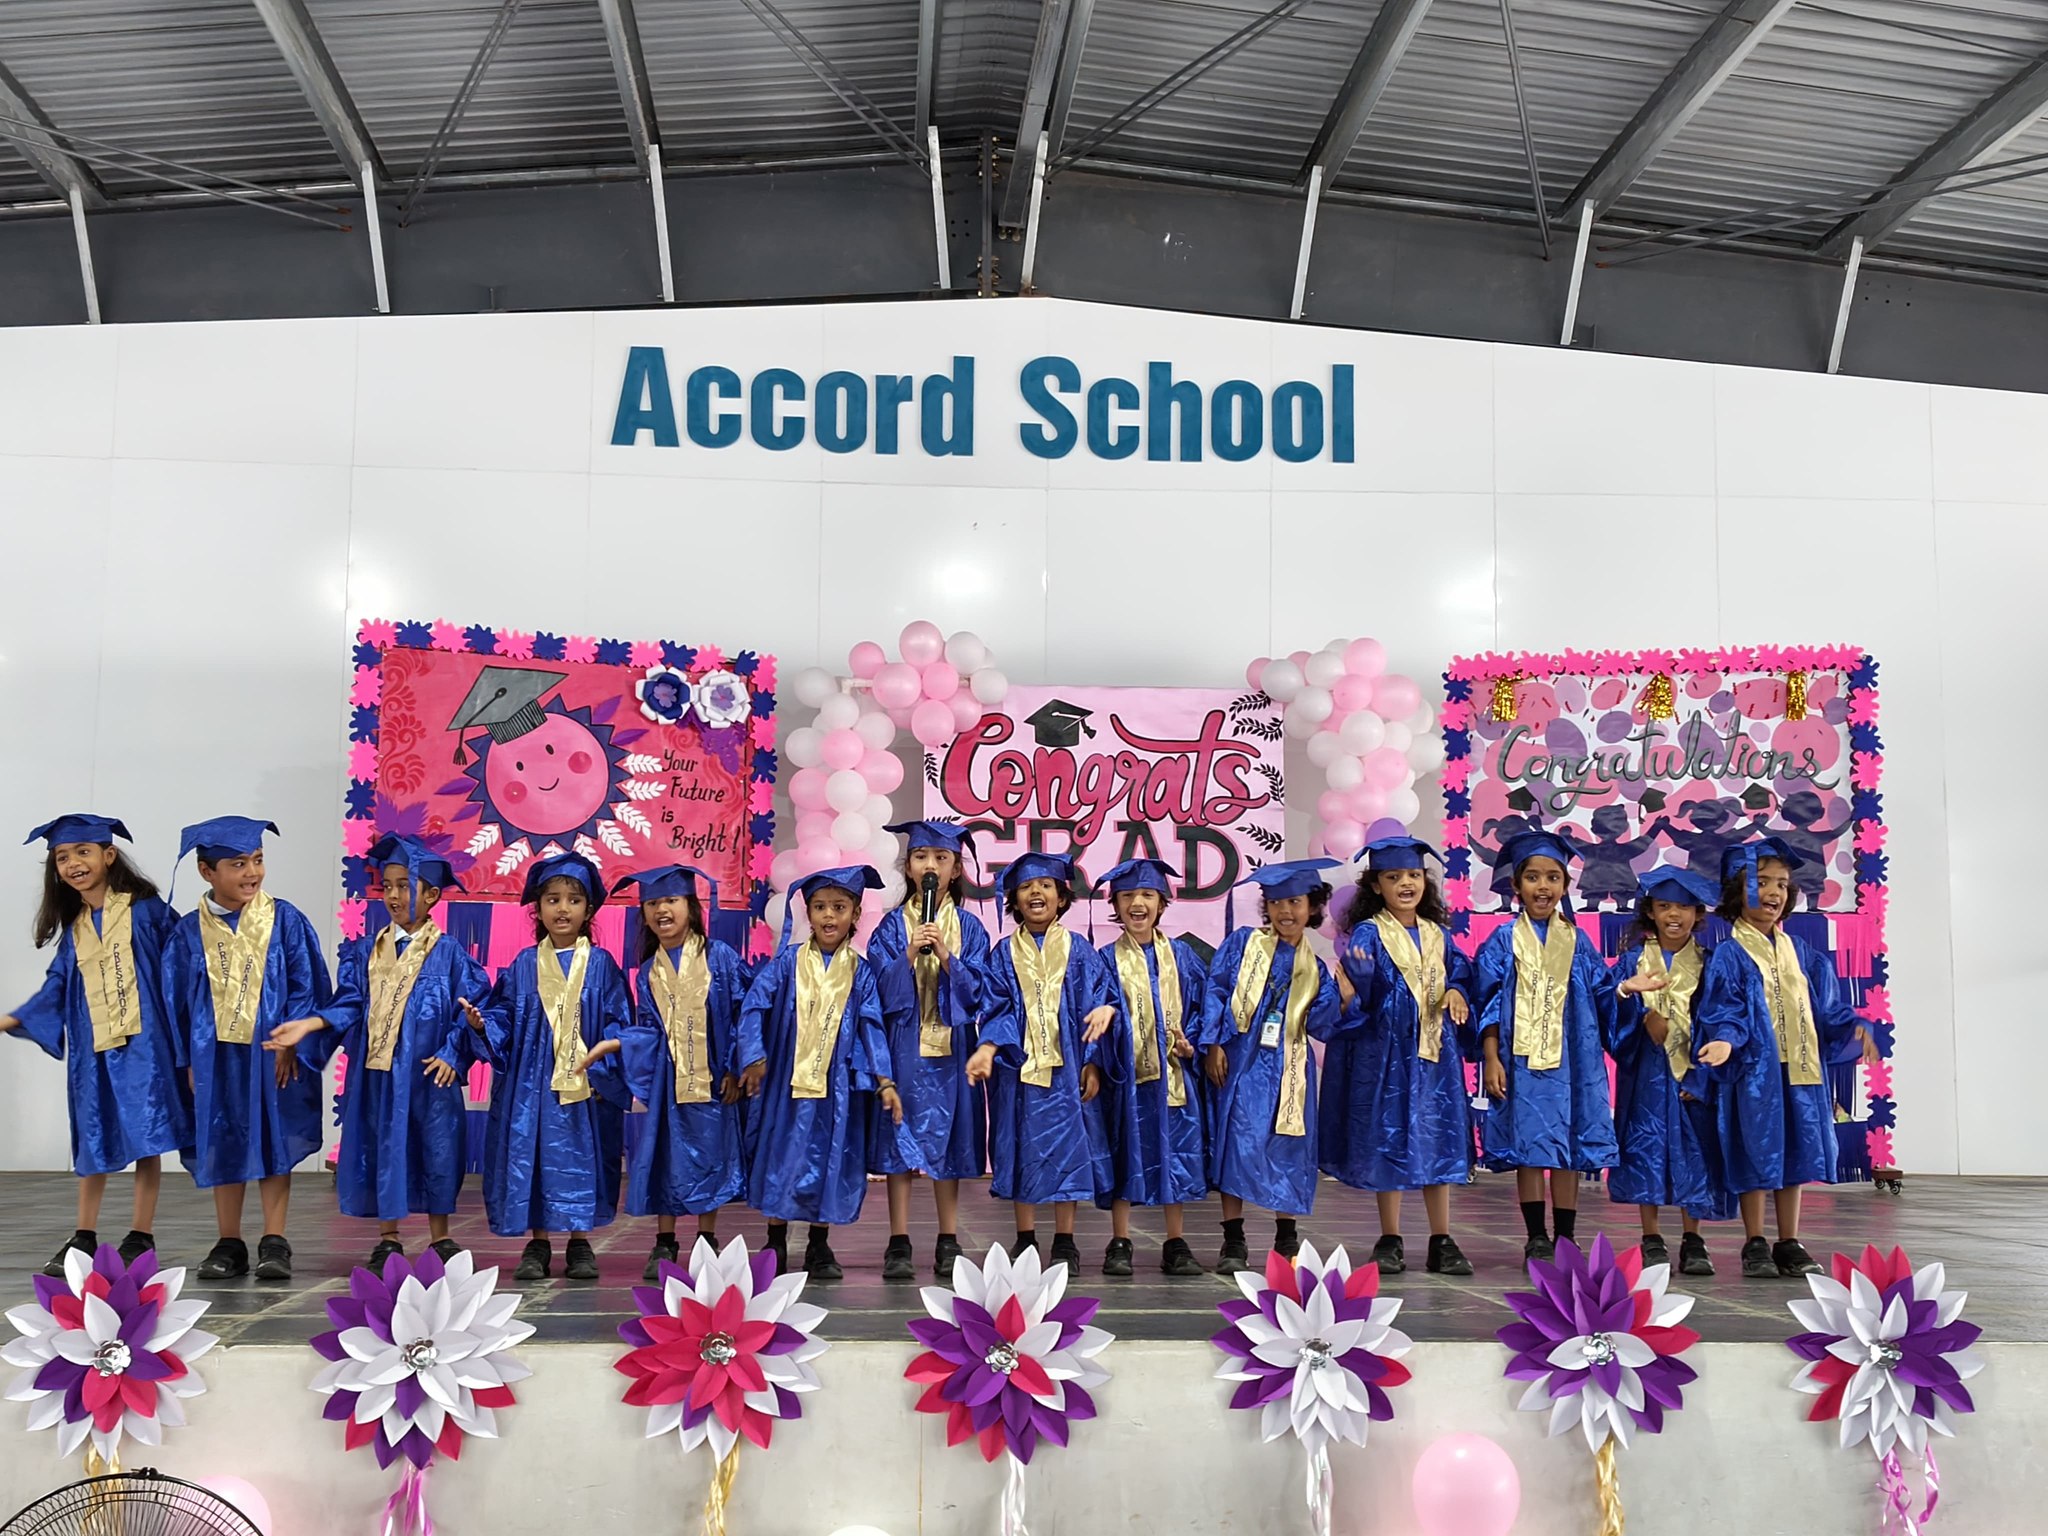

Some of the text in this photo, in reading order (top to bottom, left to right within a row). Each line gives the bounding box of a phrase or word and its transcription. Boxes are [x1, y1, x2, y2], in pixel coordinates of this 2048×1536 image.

[610, 346, 1355, 463] Accord School
[662, 748, 698, 774] Your
[670, 776, 726, 804] Future
[940, 709, 1270, 846] Congrats
[1495, 709, 1841, 816] Congratulations
[661, 806, 675, 824] is
[959, 817, 1242, 902] GRAD
[113, 942, 127, 1027] PRESCHOOL
[230, 954, 254, 1032] GRADUATE
[1034, 979, 1049, 1056] GRADUATE
[1238, 950, 1263, 1020] GRADUATE
[1540, 976, 1555, 1061] PRESCHOOL
[687, 1015, 695, 1092] GRADUATE
[812, 1004, 836, 1080] GRADUATE
[1137, 993, 1151, 1069] GRADUATE
